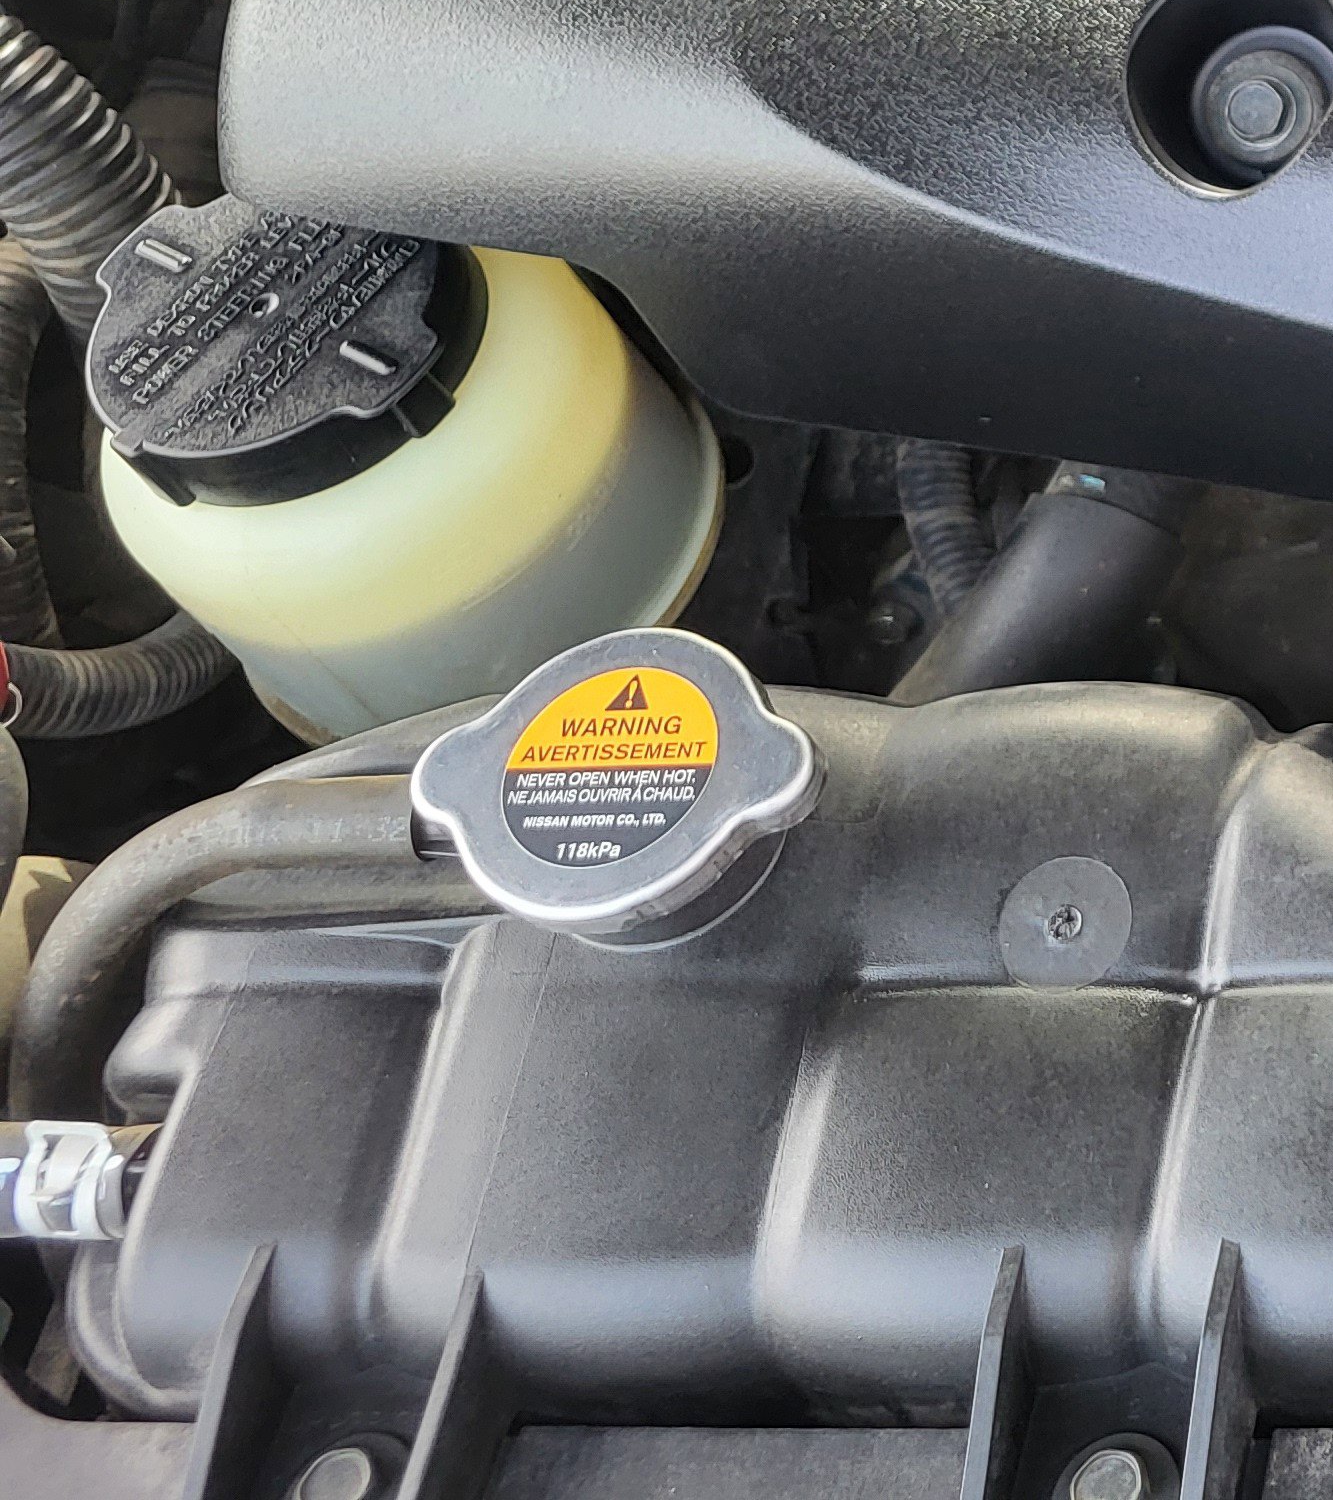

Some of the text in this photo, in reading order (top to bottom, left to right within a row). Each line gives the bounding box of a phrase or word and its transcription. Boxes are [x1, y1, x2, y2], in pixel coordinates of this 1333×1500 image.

[118, 342, 170, 386] FILL
[165, 313, 196, 333] TO
[131, 344, 198, 403] POWER
[562, 716, 682, 737] WARNING
[521, 742, 707, 762] AVERTISSEMENT
[517, 769, 696, 787] NEVER OPEN WHEN HOT.
[507, 790, 527, 804] NE
[527, 789, 577, 804] JAMAIS
[579, 787, 632, 802] OUVRIR
[643, 786, 695, 801] CHAUD.
[524, 816, 570, 828] NISSAN
[571, 815, 613, 827] MOTOR
[642, 813, 666, 825] LTD.
[557, 842, 621, 860] 118kPa
